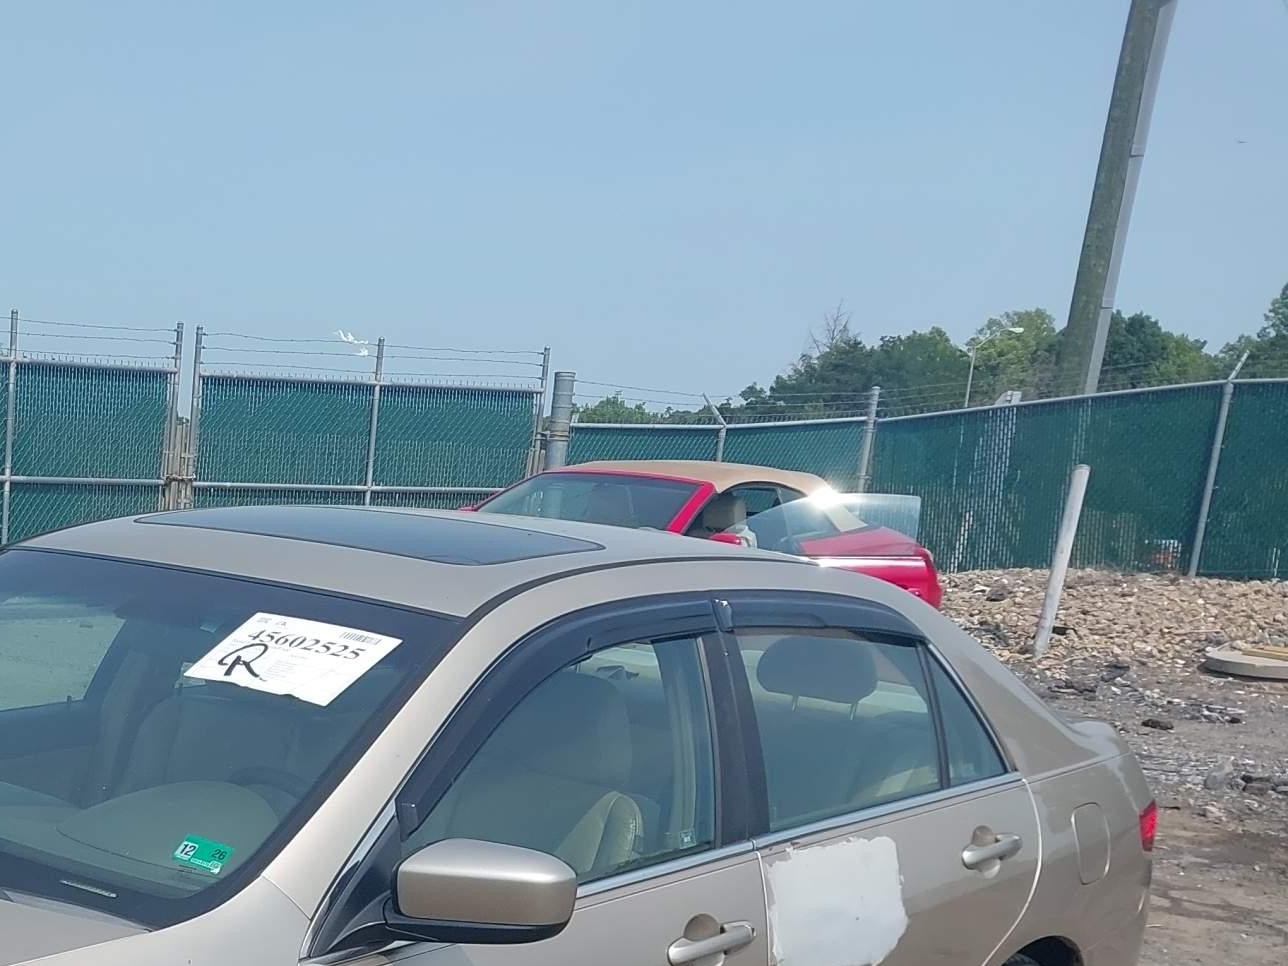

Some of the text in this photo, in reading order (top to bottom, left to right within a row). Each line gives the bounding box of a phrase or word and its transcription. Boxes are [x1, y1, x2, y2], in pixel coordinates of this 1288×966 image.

[248, 629, 366, 660] 45602525
[180, 843, 227, 860] 12 26
